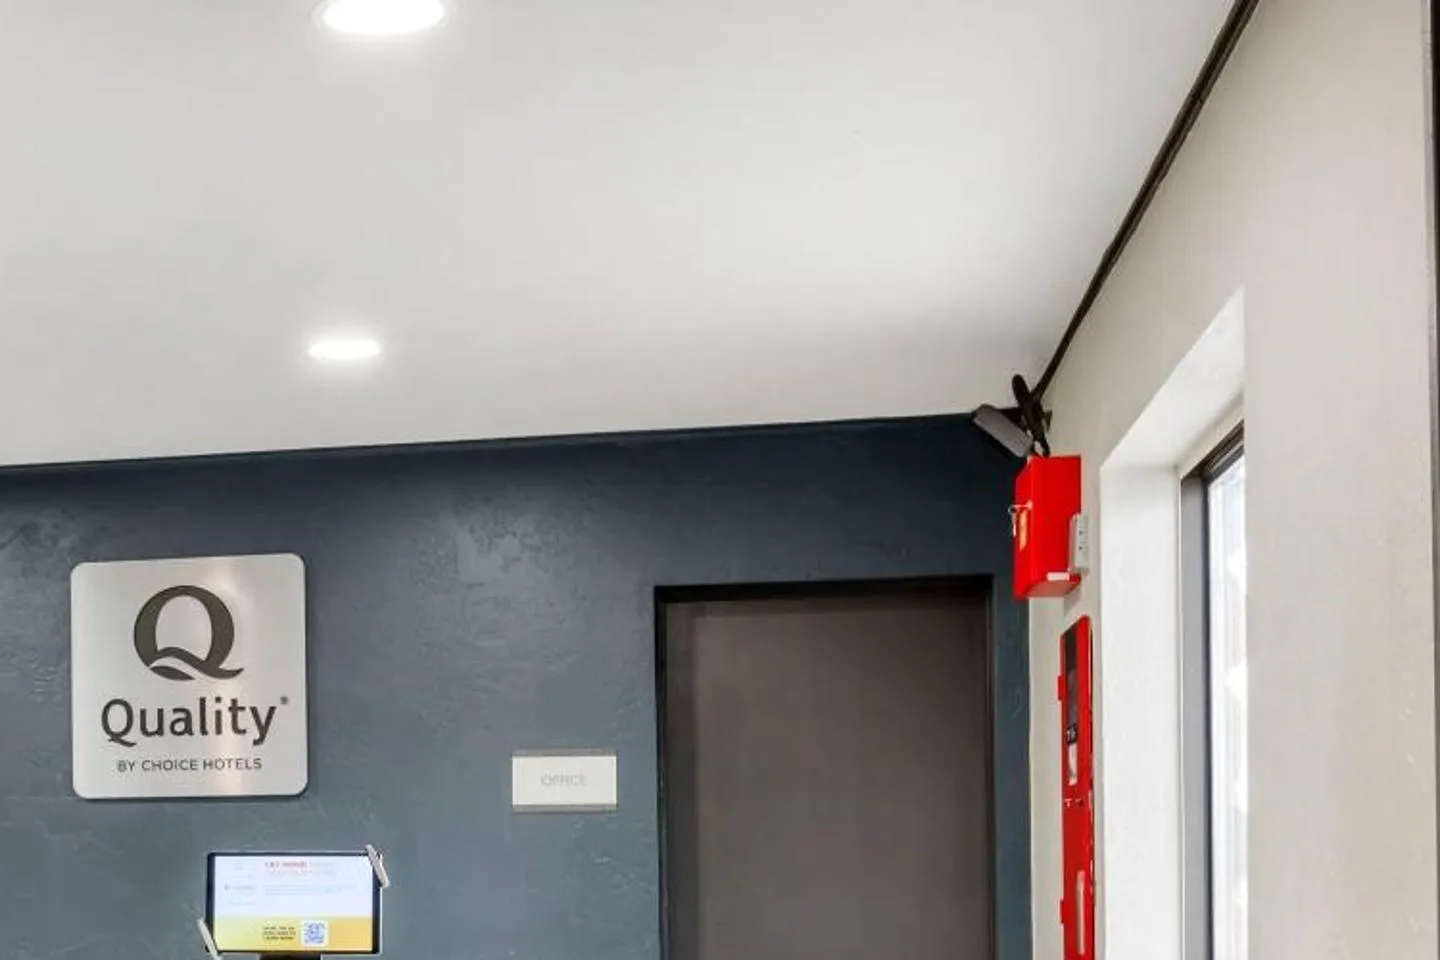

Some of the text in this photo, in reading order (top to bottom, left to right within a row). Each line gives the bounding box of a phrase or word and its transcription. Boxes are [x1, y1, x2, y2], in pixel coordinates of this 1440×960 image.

[134, 585, 244, 681] Q
[101, 697, 277, 747] Quality
[117, 757, 262, 773] BY CHOICE HOTELS
